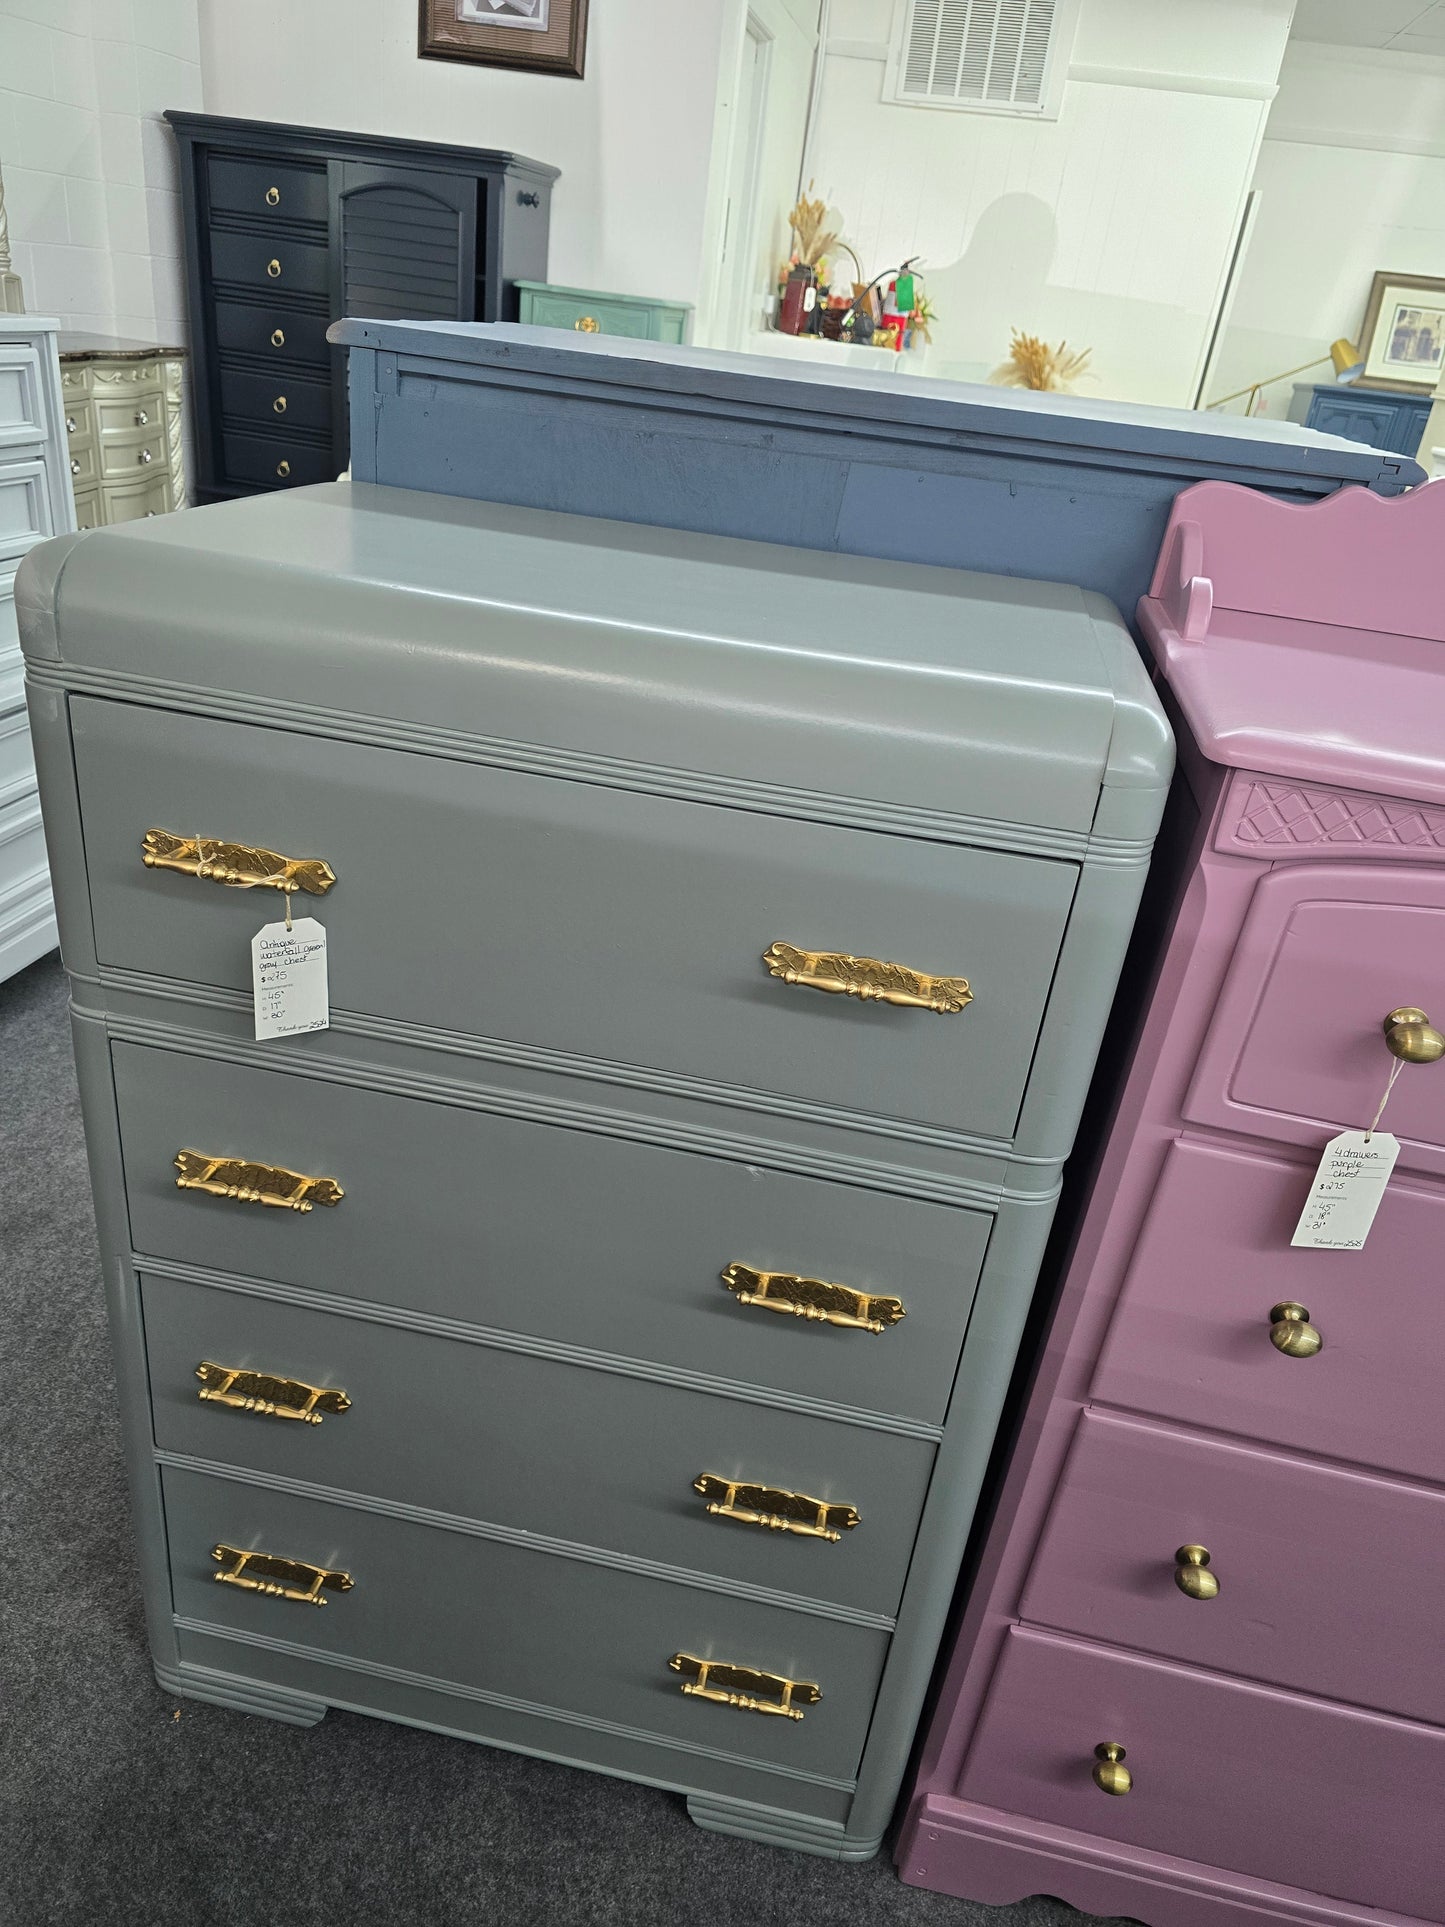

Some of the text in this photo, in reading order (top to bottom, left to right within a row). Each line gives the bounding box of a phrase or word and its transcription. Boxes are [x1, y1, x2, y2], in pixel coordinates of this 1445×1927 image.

[284, 955, 308, 966] chest
[1330, 1160, 1364, 1171] purple
[1332, 1169, 1361, 1178] chest
